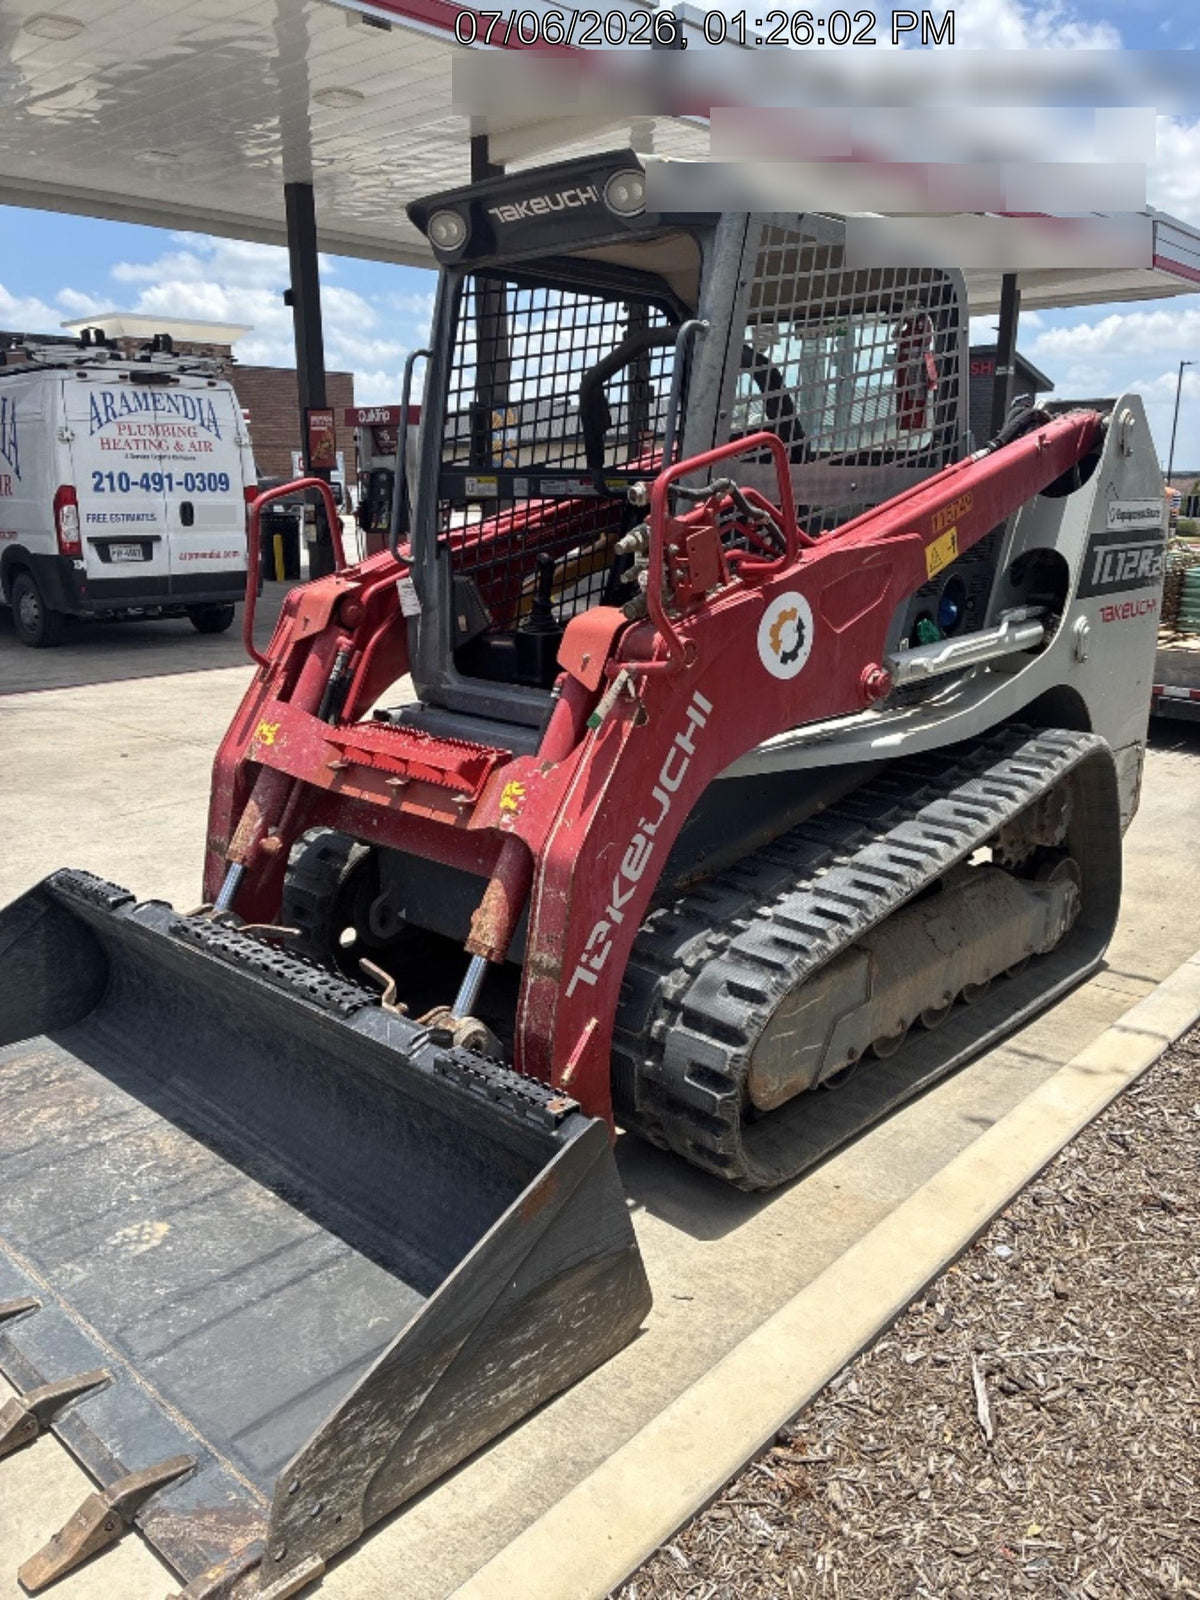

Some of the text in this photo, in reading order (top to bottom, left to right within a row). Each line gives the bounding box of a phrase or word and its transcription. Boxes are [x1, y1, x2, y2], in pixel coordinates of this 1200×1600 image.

[488, 186, 598, 224] TAKEUCHI
[89, 391, 223, 441] ARAMENDIA
[118, 423, 198, 438] PLUMBING
[100, 437, 214, 452] HEATING & AIR
[92, 470, 230, 493] 210-491-0309
[86, 512, 157, 523] FREE ESTIMATES
[1100, 600, 1157, 623] TAKEUCHI
[565, 690, 714, 999] TAKEUCHI
